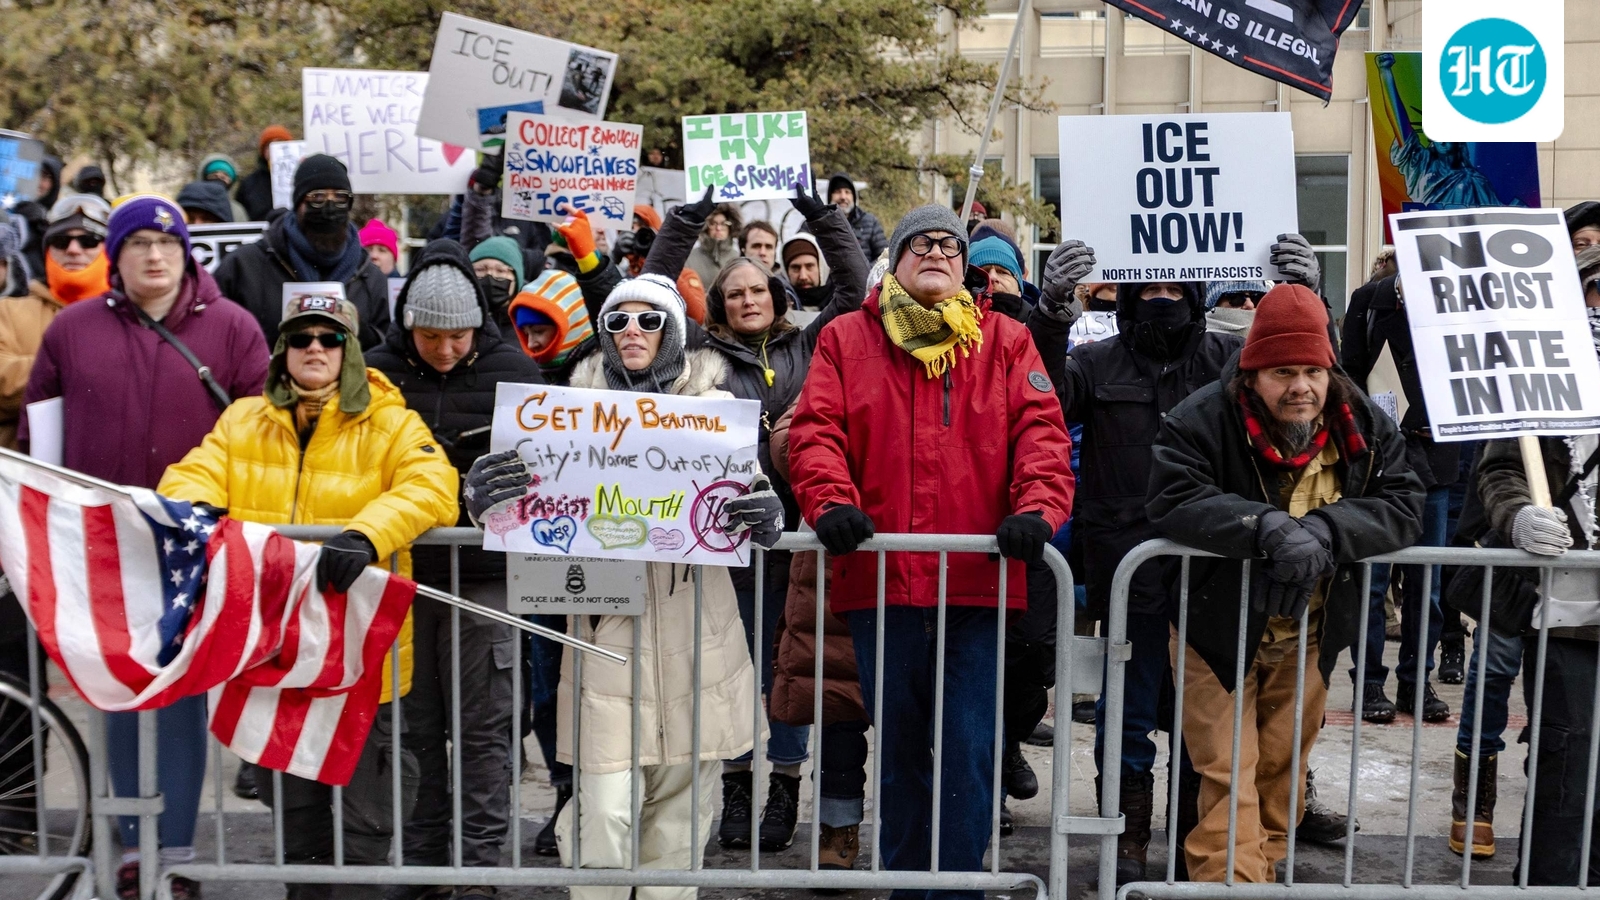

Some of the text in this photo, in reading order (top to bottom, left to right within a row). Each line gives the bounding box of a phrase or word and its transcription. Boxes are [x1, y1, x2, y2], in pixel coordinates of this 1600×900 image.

[452, 27, 514, 63] ICE
[1217, 8, 1240, 29] IS
[1245, 21, 1320, 65] ILLEGAL
[307, 72, 422, 98] IMMIGR
[492, 60, 553, 96] OUT!
[310, 104, 355, 126] ARE
[686, 112, 804, 140] I LIKE
[322, 128, 439, 176] HERE
[518, 119, 639, 151] COLLECT ENOUGH
[719, 137, 771, 167] MY
[1141, 121, 1211, 163] ICE
[525, 149, 637, 176] SNOWFLAKES
[688, 163, 730, 192] ICE
[510, 173, 543, 189] AND
[1136, 167, 1220, 208] OUT
[536, 193, 594, 216] ICE
[1130, 211, 1245, 255] NOW!
[1415, 229, 1554, 272] NO
[1102, 266, 1263, 281] NORTH STAR ANTIFASCISTS
[303, 297, 335, 309] FDT
[1430, 272, 1554, 314] RACIST
[1443, 330, 1570, 373] HATE
[515, 391, 584, 432] GET
[1450, 373, 1584, 417] IN MN
[645, 446, 689, 473] Out
[699, 494, 733, 535] IC
[539, 523, 570, 543] MSP
